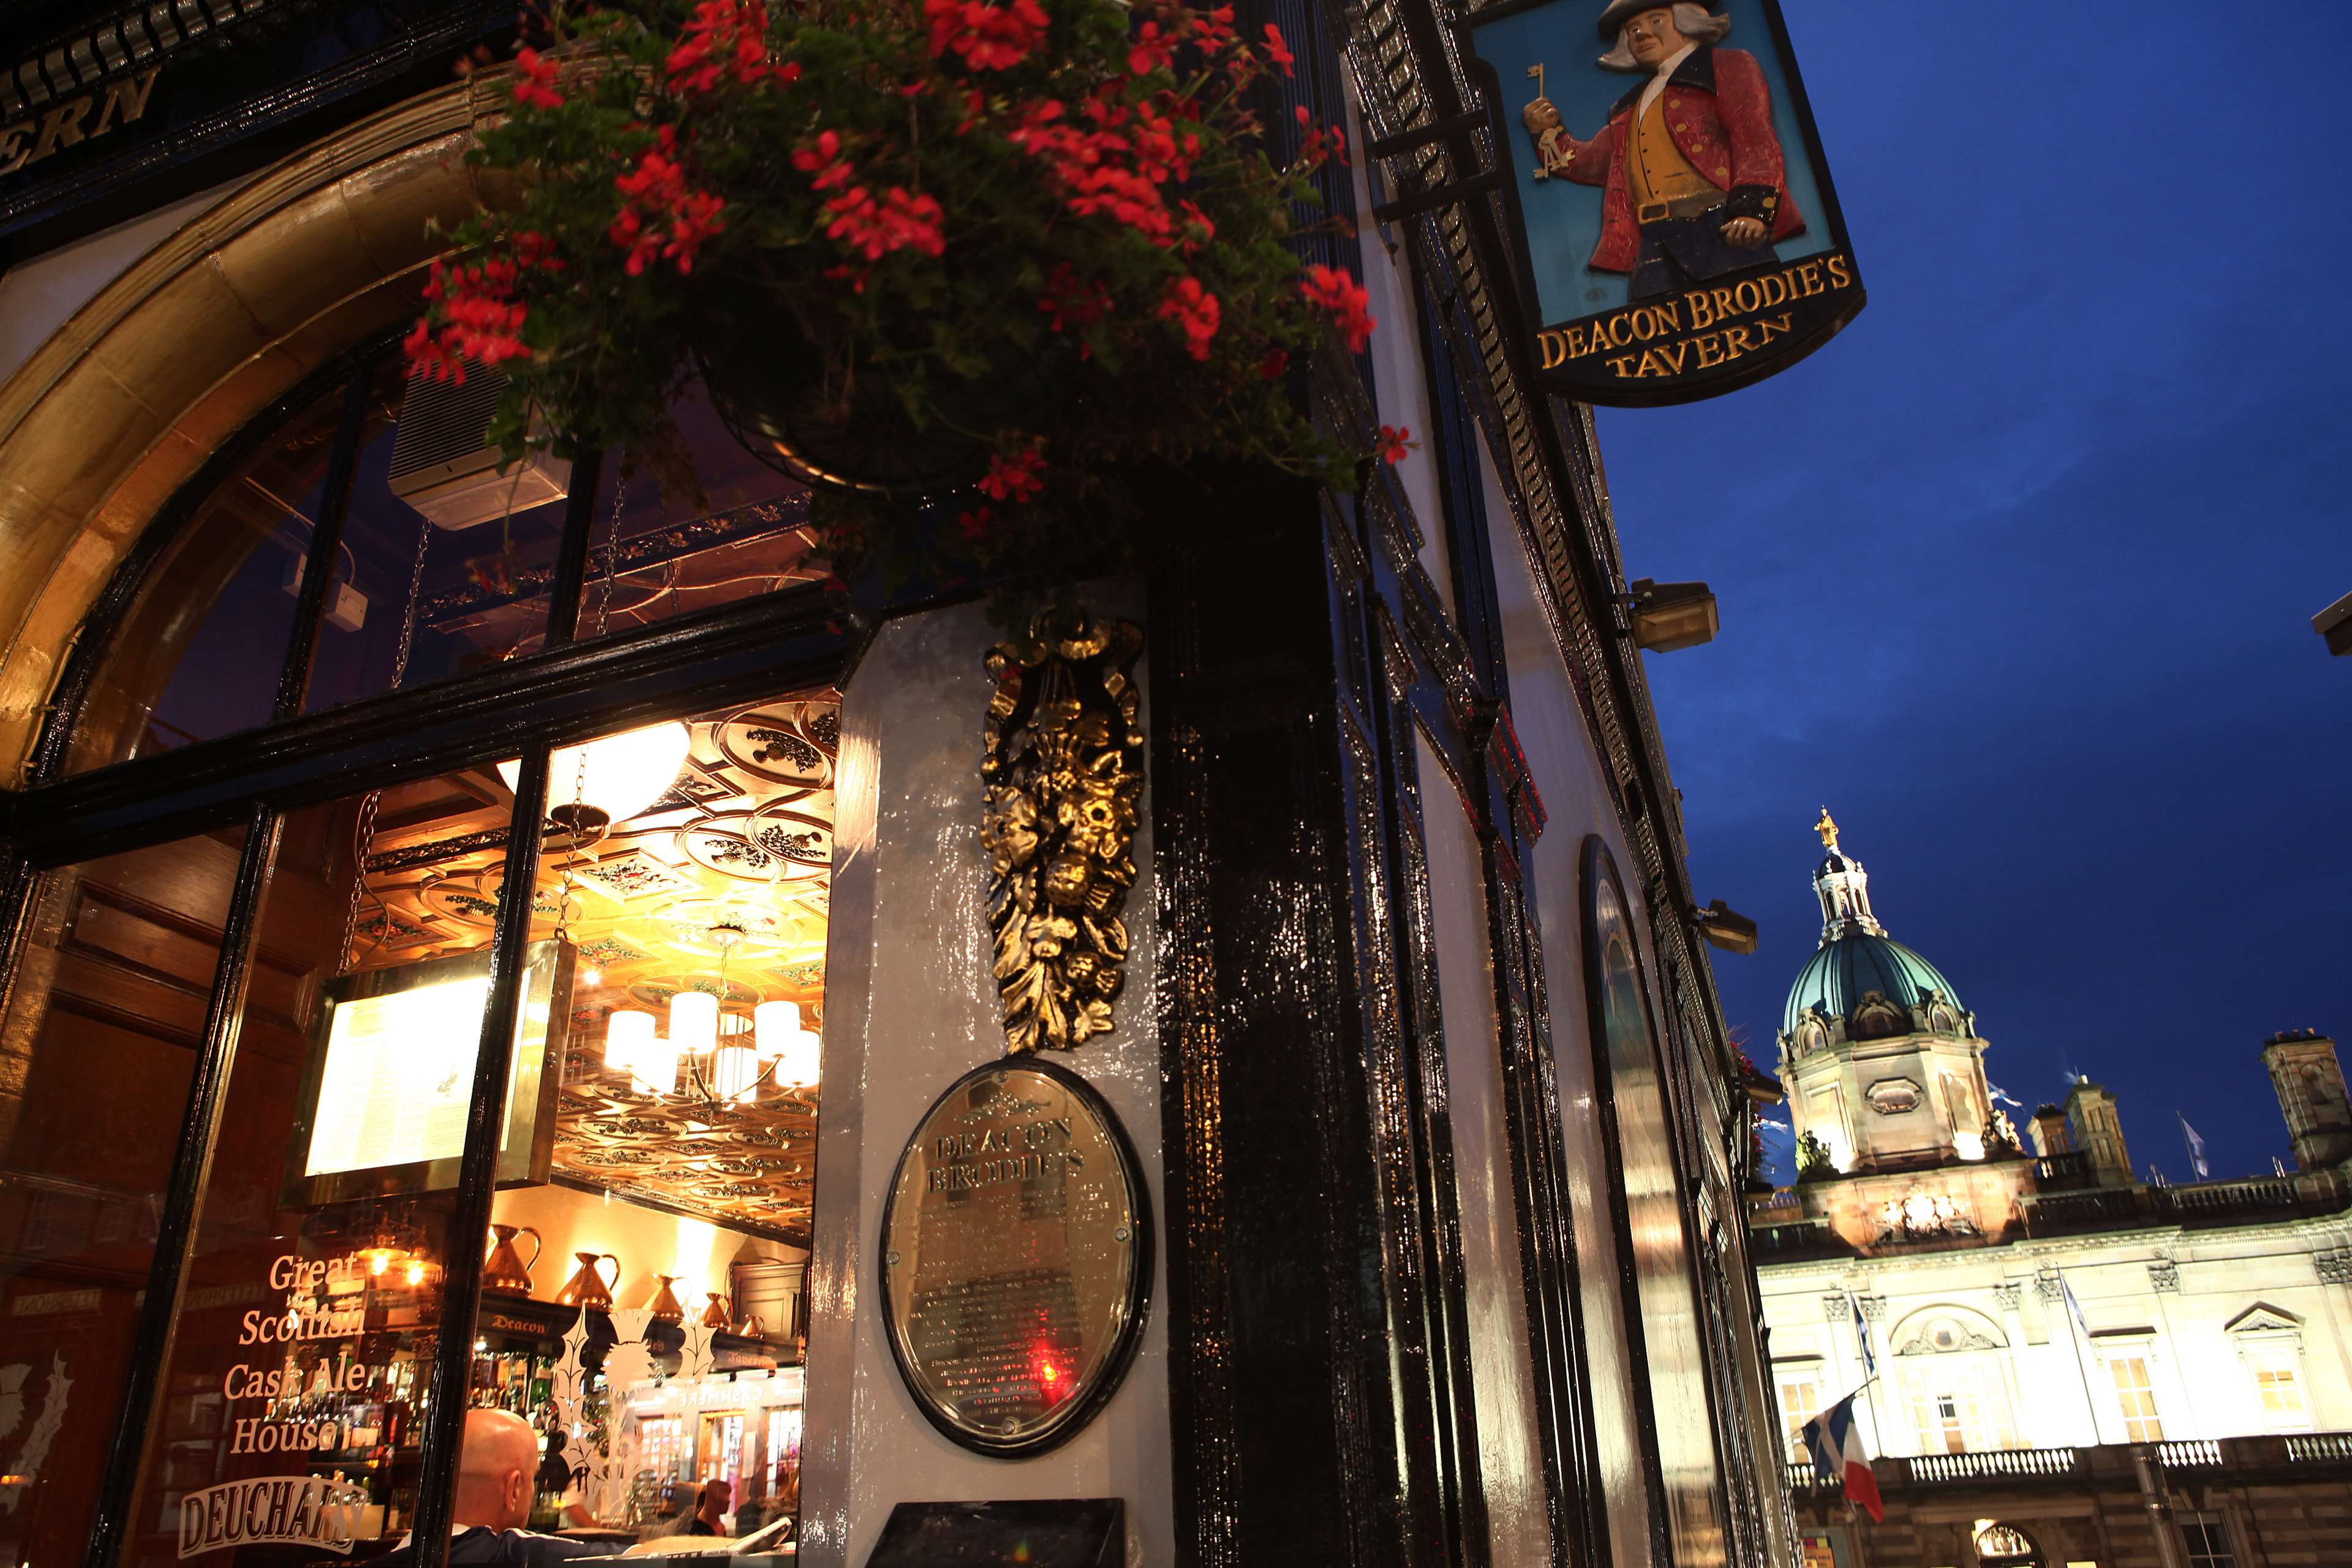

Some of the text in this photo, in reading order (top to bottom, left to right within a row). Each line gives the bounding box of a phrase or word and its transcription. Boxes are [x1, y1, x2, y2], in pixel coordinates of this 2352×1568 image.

[1536, 254, 1852, 370] DEACON BRODIE'S
[1605, 311, 1793, 379] TAVERN
[935, 1117, 1073, 1161] DEACON
[270, 1251, 358, 1290] Great
[239, 1295, 366, 1345] Scottish
[492, 1314, 546, 1334] Deacon
[224, 1351, 366, 1400] Cask Ale
[230, 1417, 338, 1455] House
